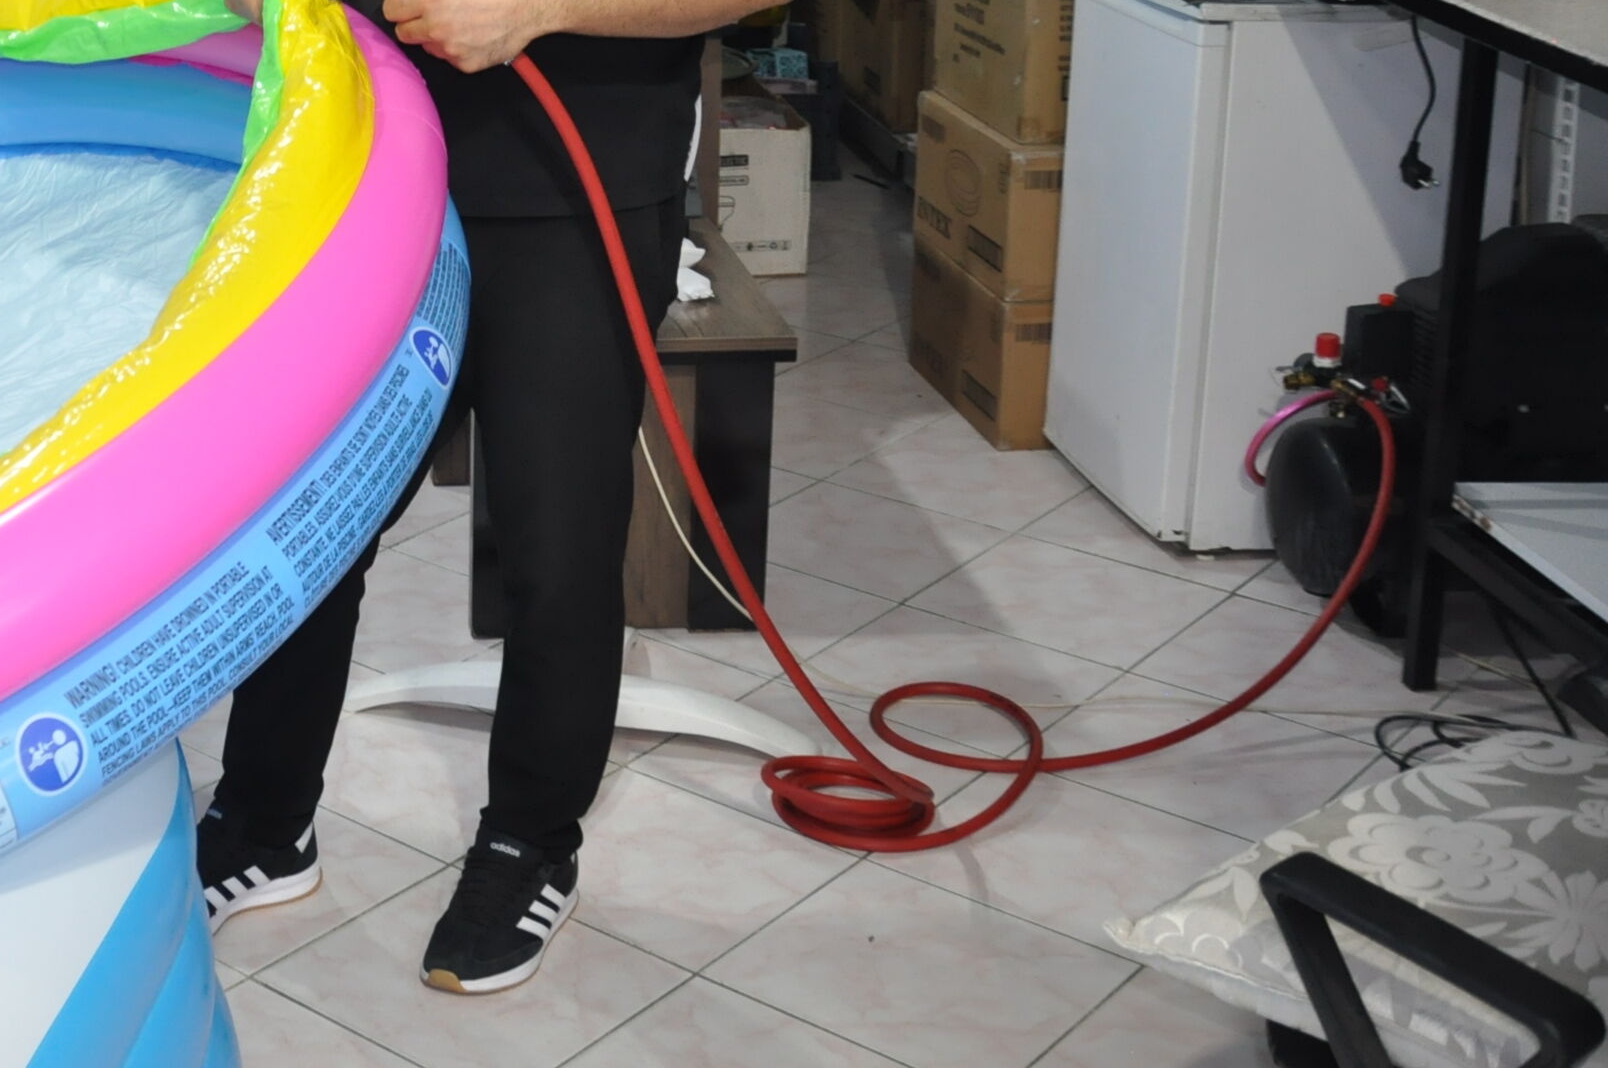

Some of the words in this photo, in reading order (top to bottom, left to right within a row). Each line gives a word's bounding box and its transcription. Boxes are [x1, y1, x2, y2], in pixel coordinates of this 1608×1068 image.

[917, 195, 952, 240] INTEX
[202, 588, 217, 606] IN
[209, 559, 250, 600] PORTABLE
[169, 595, 209, 633] DROWNED
[151, 622, 177, 648] HAVE
[115, 637, 157, 675] CHILDREN
[63, 661, 120, 710] WARNING!
[489, 842, 521, 858] adidas
